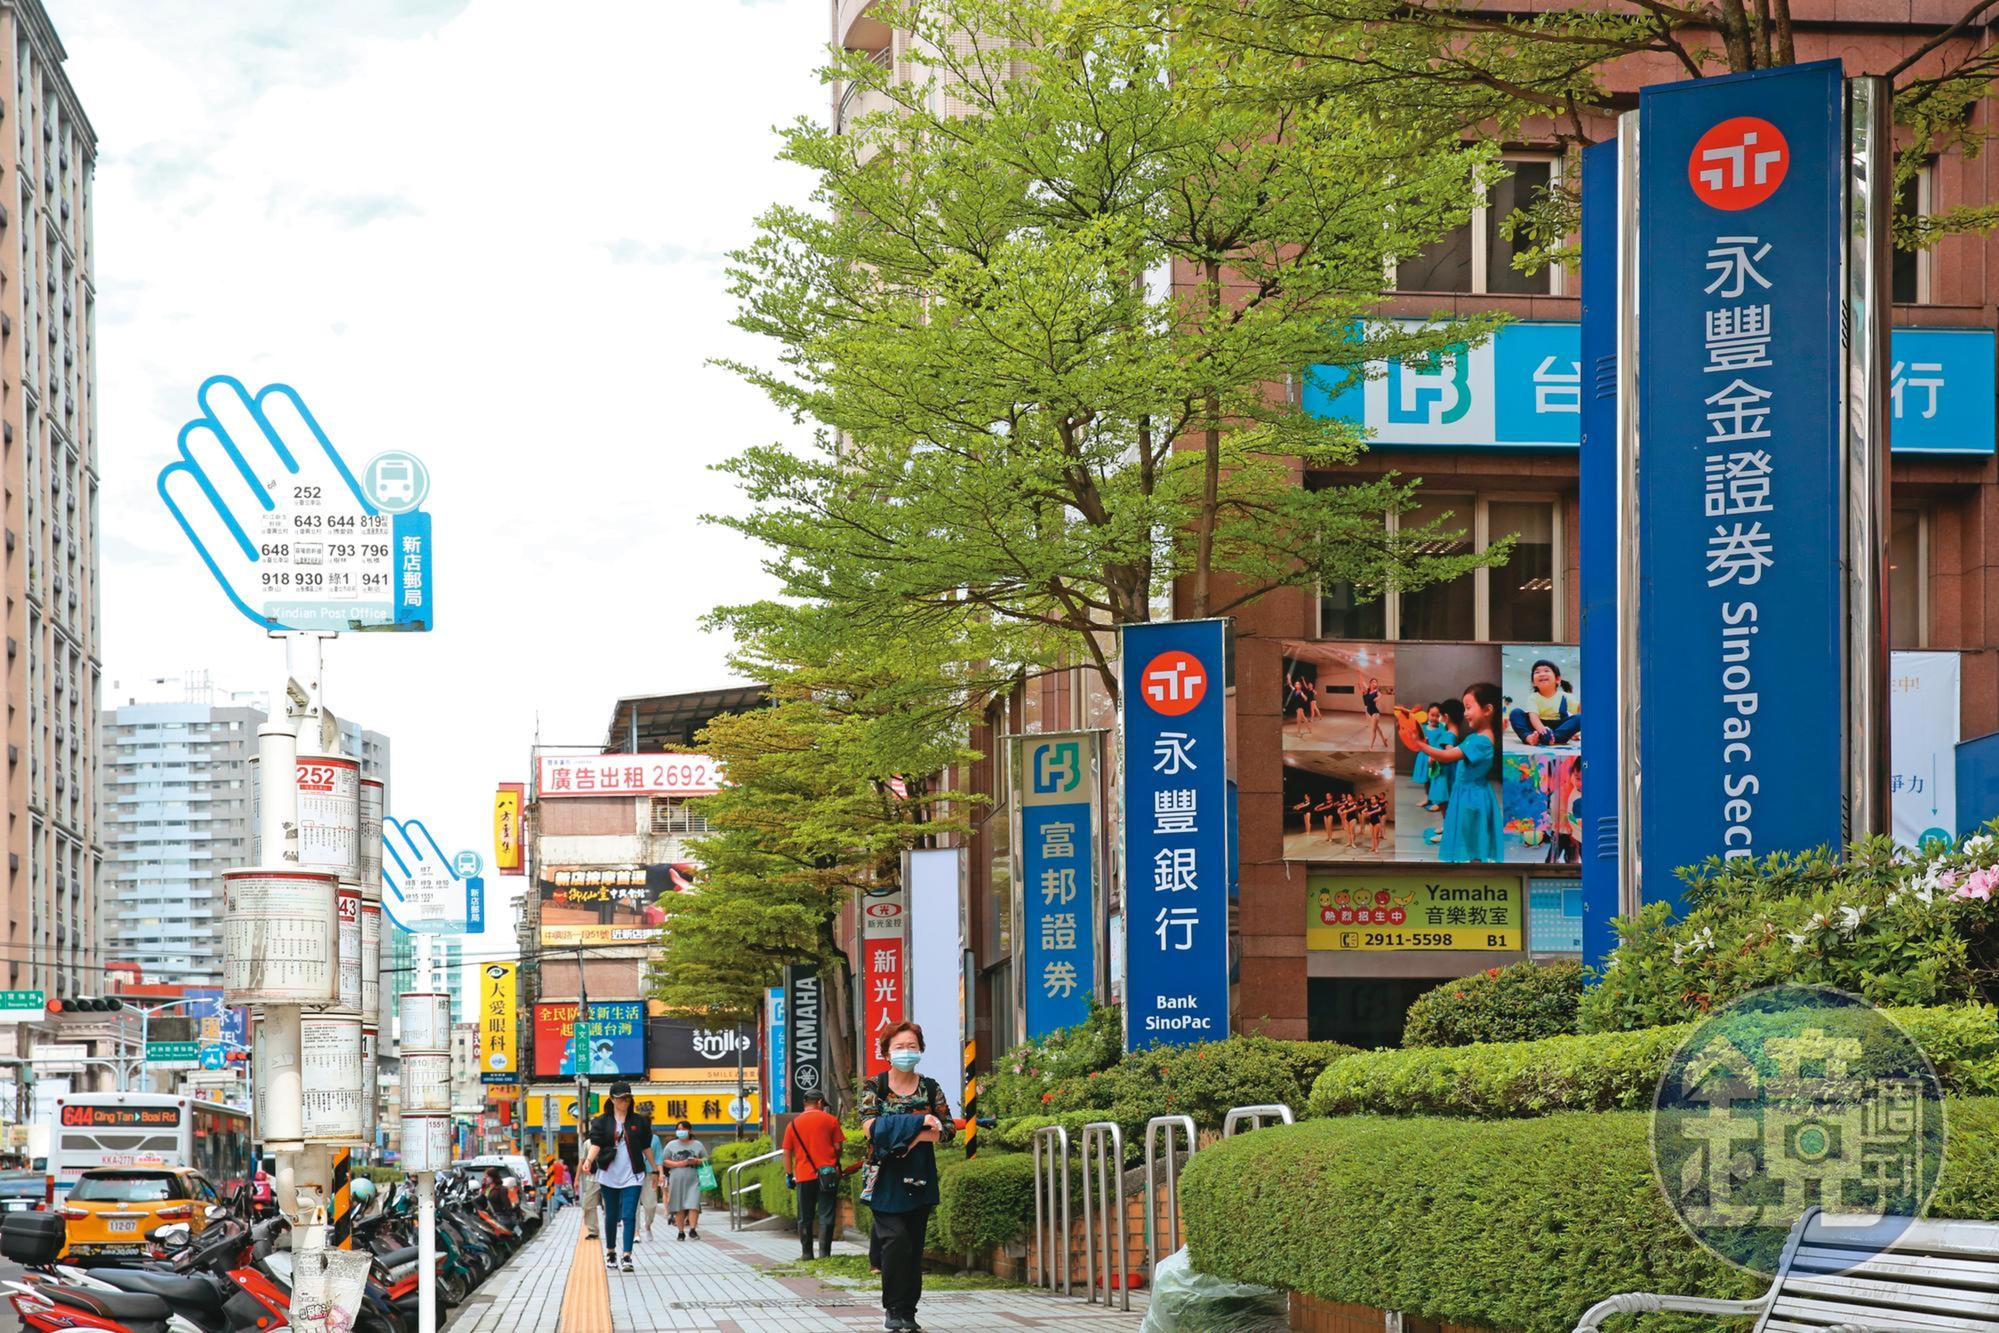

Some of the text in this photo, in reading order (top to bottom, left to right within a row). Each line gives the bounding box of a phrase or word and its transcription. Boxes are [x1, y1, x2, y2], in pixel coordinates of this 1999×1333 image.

[1891, 360, 1944, 418] 行
[1703, 235, 1775, 588] 永豐金證券
[294, 486, 322, 499] 252
[294, 515, 381, 528] 643 644 819
[261, 544, 289, 556] 648
[328, 544, 355, 557] 793
[361, 544, 389, 557] 796
[261, 572, 389, 586] 918 930 綠1 941
[402, 536, 423, 607] 新店郵局
[272, 606, 387, 618] Xindian Post Office
[1722, 601, 1759, 763] SinoPac
[296, 766, 335, 785] 252
[551, 766, 645, 790] 廣告出租
[1152, 731, 1200, 951] 永豐銀行
[1425, 884, 1508, 901] Yamaha
[338, 897, 357, 917] 43
[1039, 822, 1078, 998] 富邦證券
[1324, 910, 1403, 923] 熱烈招生中
[1425, 905, 1509, 925] 音樂教室
[867, 918, 902, 929] 新光金控
[1364, 933, 1453, 946] 2911-5598
[1487, 934, 1507, 947] B1
[1156, 995, 1198, 1010] Bank
[489, 983, 506, 1051] 大愛眼科
[796, 976, 817, 1062] YAMAHA
[1145, 1014, 1211, 1030] SinoPac
[545, 1021, 633, 1037] 一起護台灣
[692, 1029, 751, 1052] smile
[63, 1106, 93, 1127] 644
[95, 1110, 115, 1124] Qing
[117, 1110, 134, 1122] Tan
